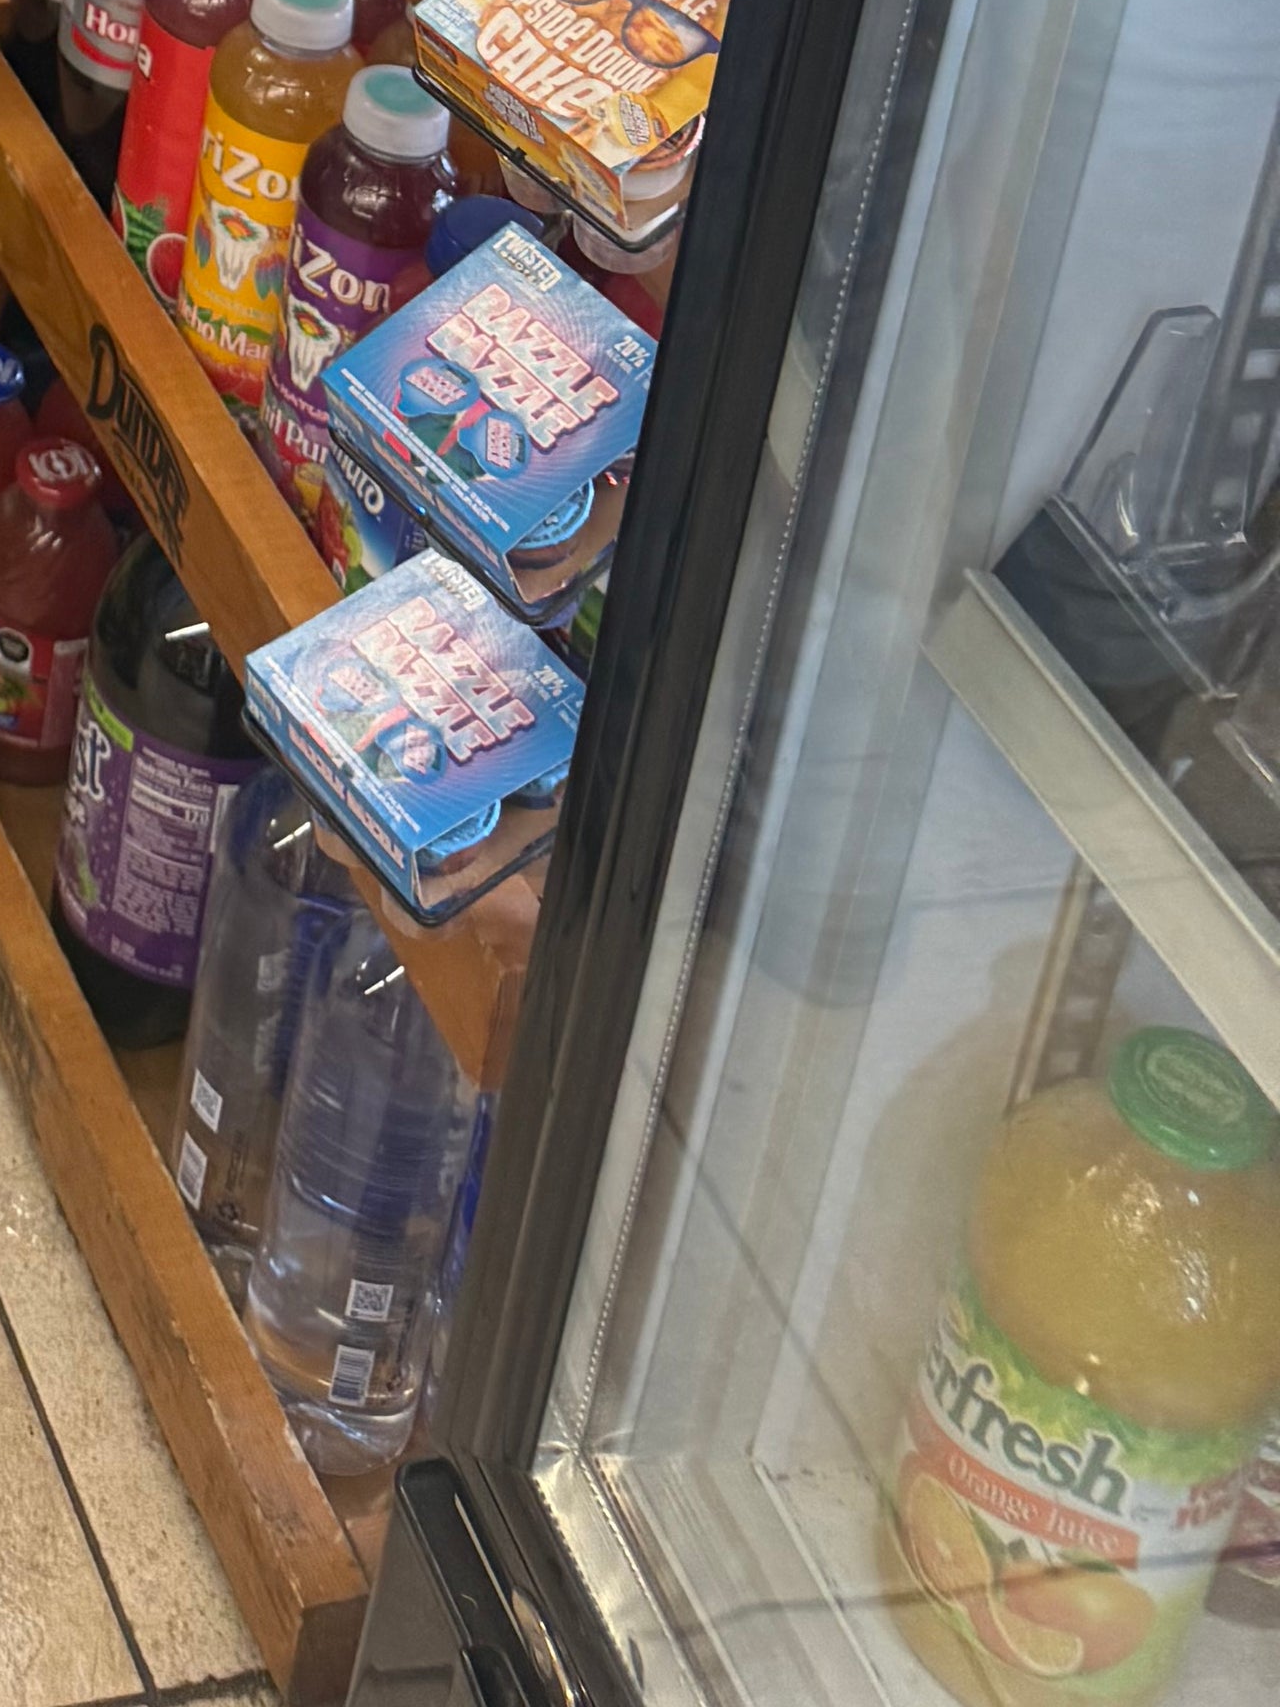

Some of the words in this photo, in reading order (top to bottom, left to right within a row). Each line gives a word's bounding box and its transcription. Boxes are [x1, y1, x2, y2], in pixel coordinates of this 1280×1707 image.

[578, 26, 669, 94] DOWN
[493, 227, 563, 289] TWISTED
[425, 311, 584, 454] DAZZLE
[460, 283, 621, 429] RAZZLE
[351, 617, 496, 766] DAZZLE
[385, 592, 535, 741] RAZZLE
[947, 1451, 1040, 1525] Orange
[1046, 1504, 1121, 1552] Juice
